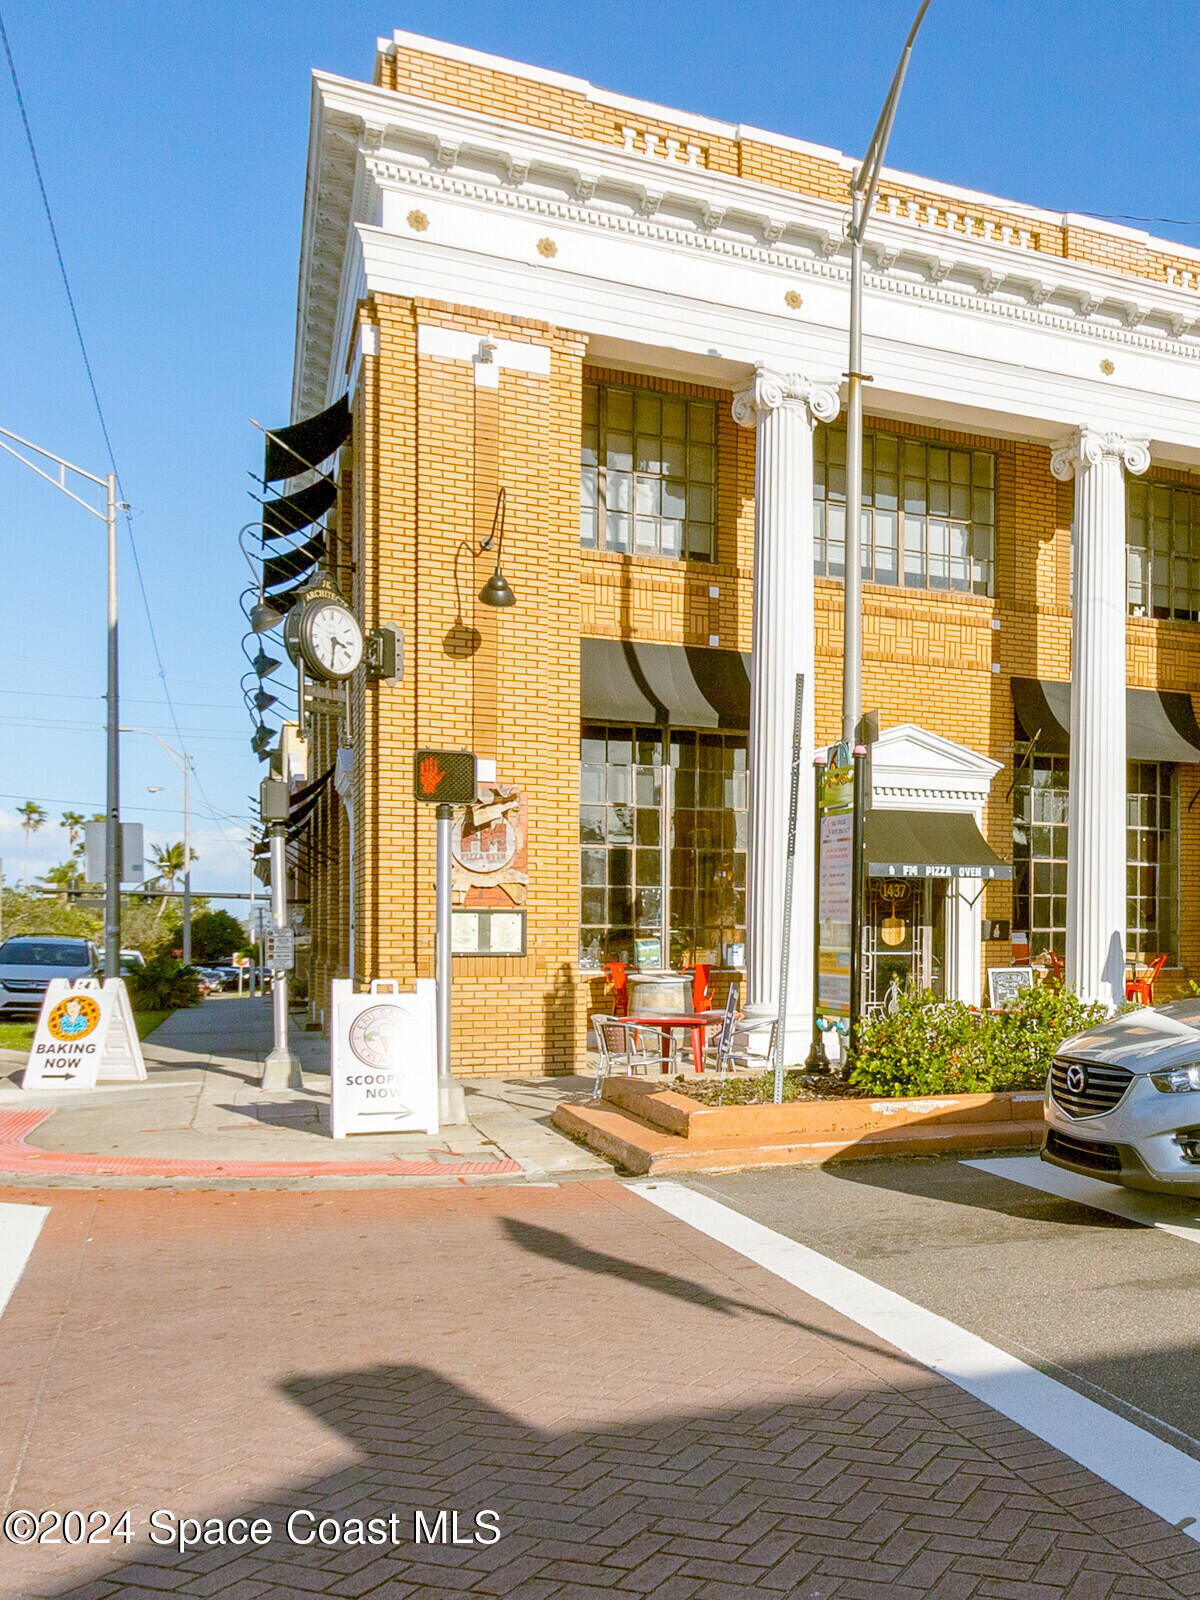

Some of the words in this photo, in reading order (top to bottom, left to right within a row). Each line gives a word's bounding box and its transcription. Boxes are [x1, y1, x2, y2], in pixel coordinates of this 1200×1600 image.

[925, 865, 952, 876] PIZZA
[958, 866, 982, 877] OVEN
[883, 883, 906, 898] 1437
[36, 1043, 96, 1055] BAKING
[44, 1058, 82, 1069] NOW
[365, 1087, 402, 1099] NOW
